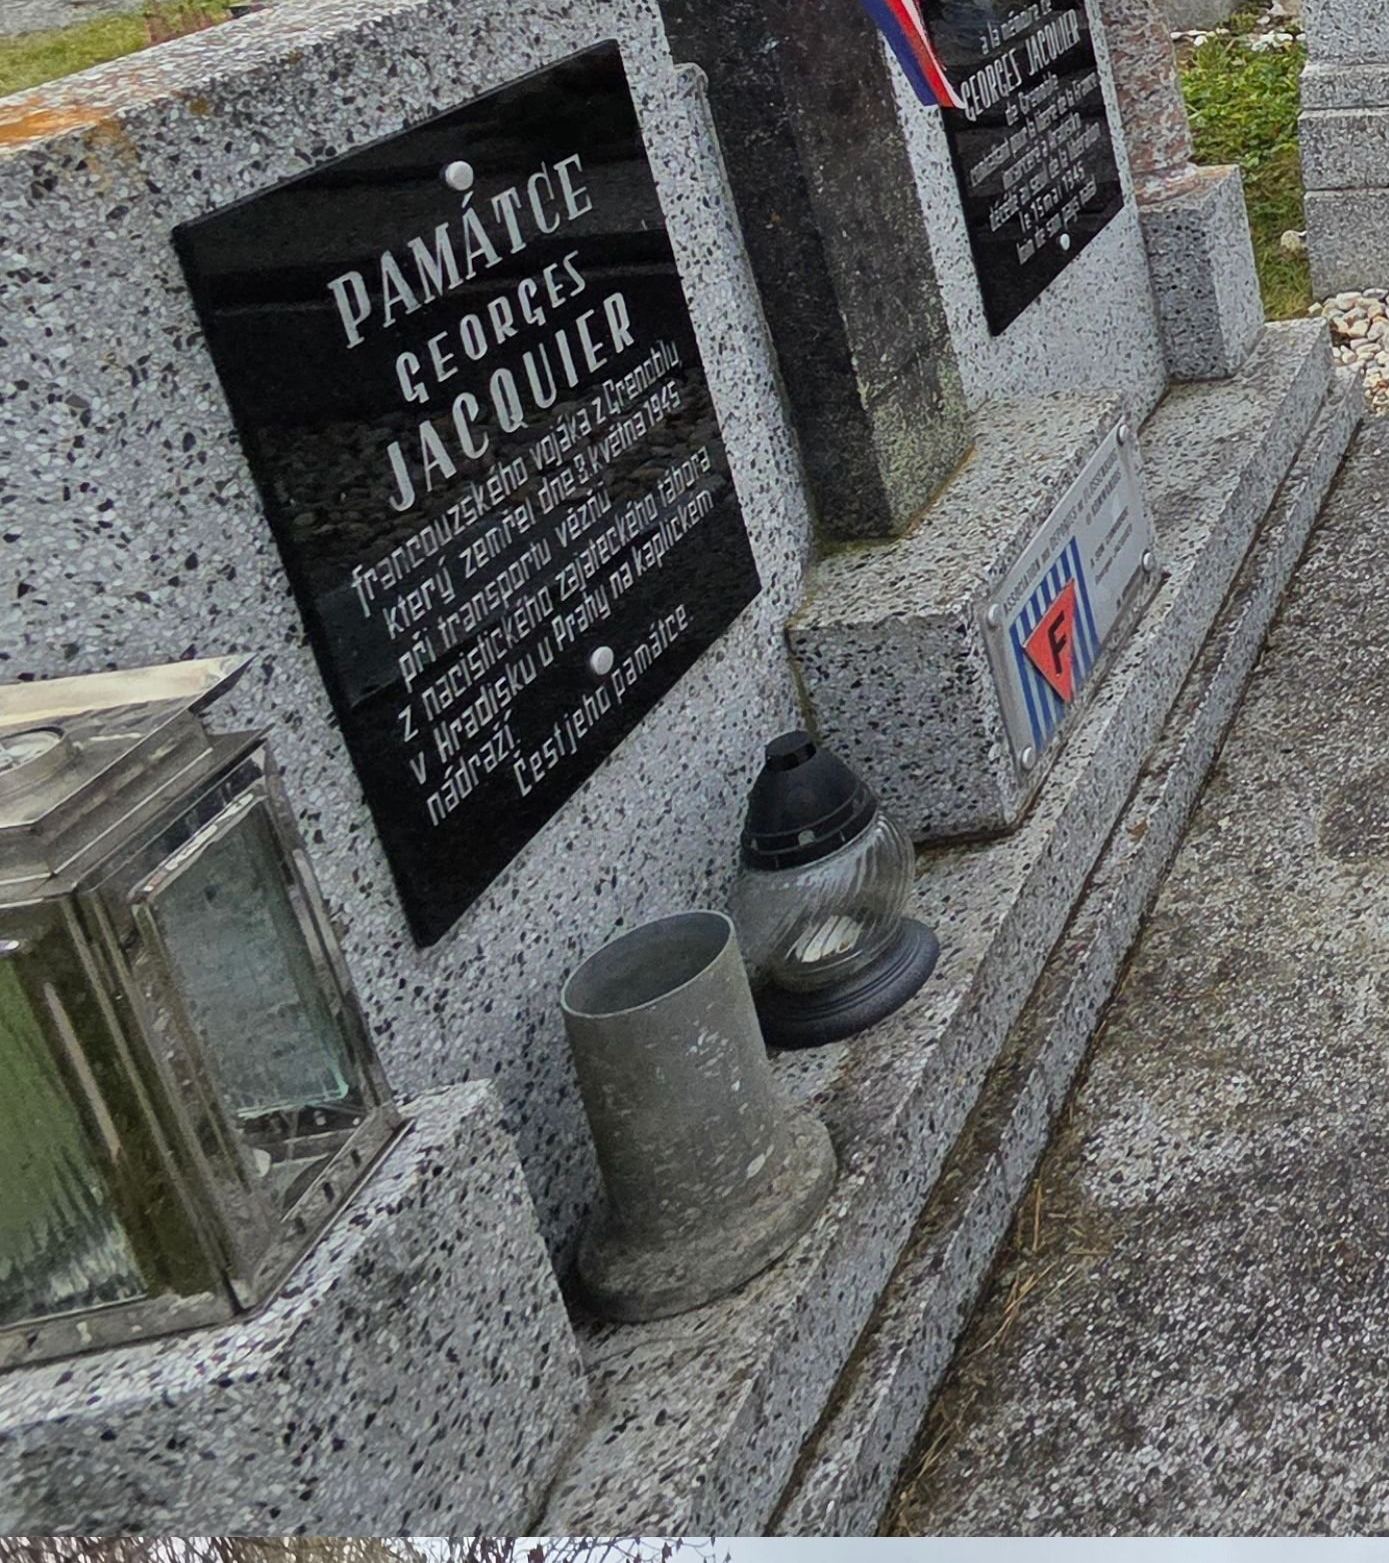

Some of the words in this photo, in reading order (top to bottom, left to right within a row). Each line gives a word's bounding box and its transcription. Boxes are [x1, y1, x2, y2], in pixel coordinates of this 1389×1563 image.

[960, 47, 1022, 121] GEORGES
[1025, 8, 1080, 75] JACQUIER
[327, 153, 593, 350] PAMÁTCE
[395, 250, 587, 404] GEORGES
[350, 456, 528, 617] francouzského
[529, 407, 592, 470] vojáka
[591, 396, 606, 424] z
[601, 340, 683, 414] Grenoblu,
[386, 291, 635, 512] JACQUIER
[382, 555, 455, 639] který
[458, 498, 535, 578] zemřel
[537, 460, 576, 514] dne
[643, 380, 680, 426] 1945
[398, 627, 436, 692] při
[437, 538, 551, 648] transportu
[554, 480, 611, 547] vězňů
[398, 705, 418, 742] z
[421, 585, 553, 720] nacistického
[554, 493, 657, 601] zajateckého
[657, 445, 710, 507] tábora
[409, 751, 426, 784] v
[433, 653, 536, 763] Hradisku
[537, 636, 553, 666] u
[551, 585, 610, 651] Prahy
[609, 561, 633, 598] na
[513, 723, 565, 796] Čest
[564, 685, 610, 754] jeho
[606, 604, 693, 703] památce.
[1047, 609, 1067, 677] F
[426, 709, 520, 825] nádraží.
